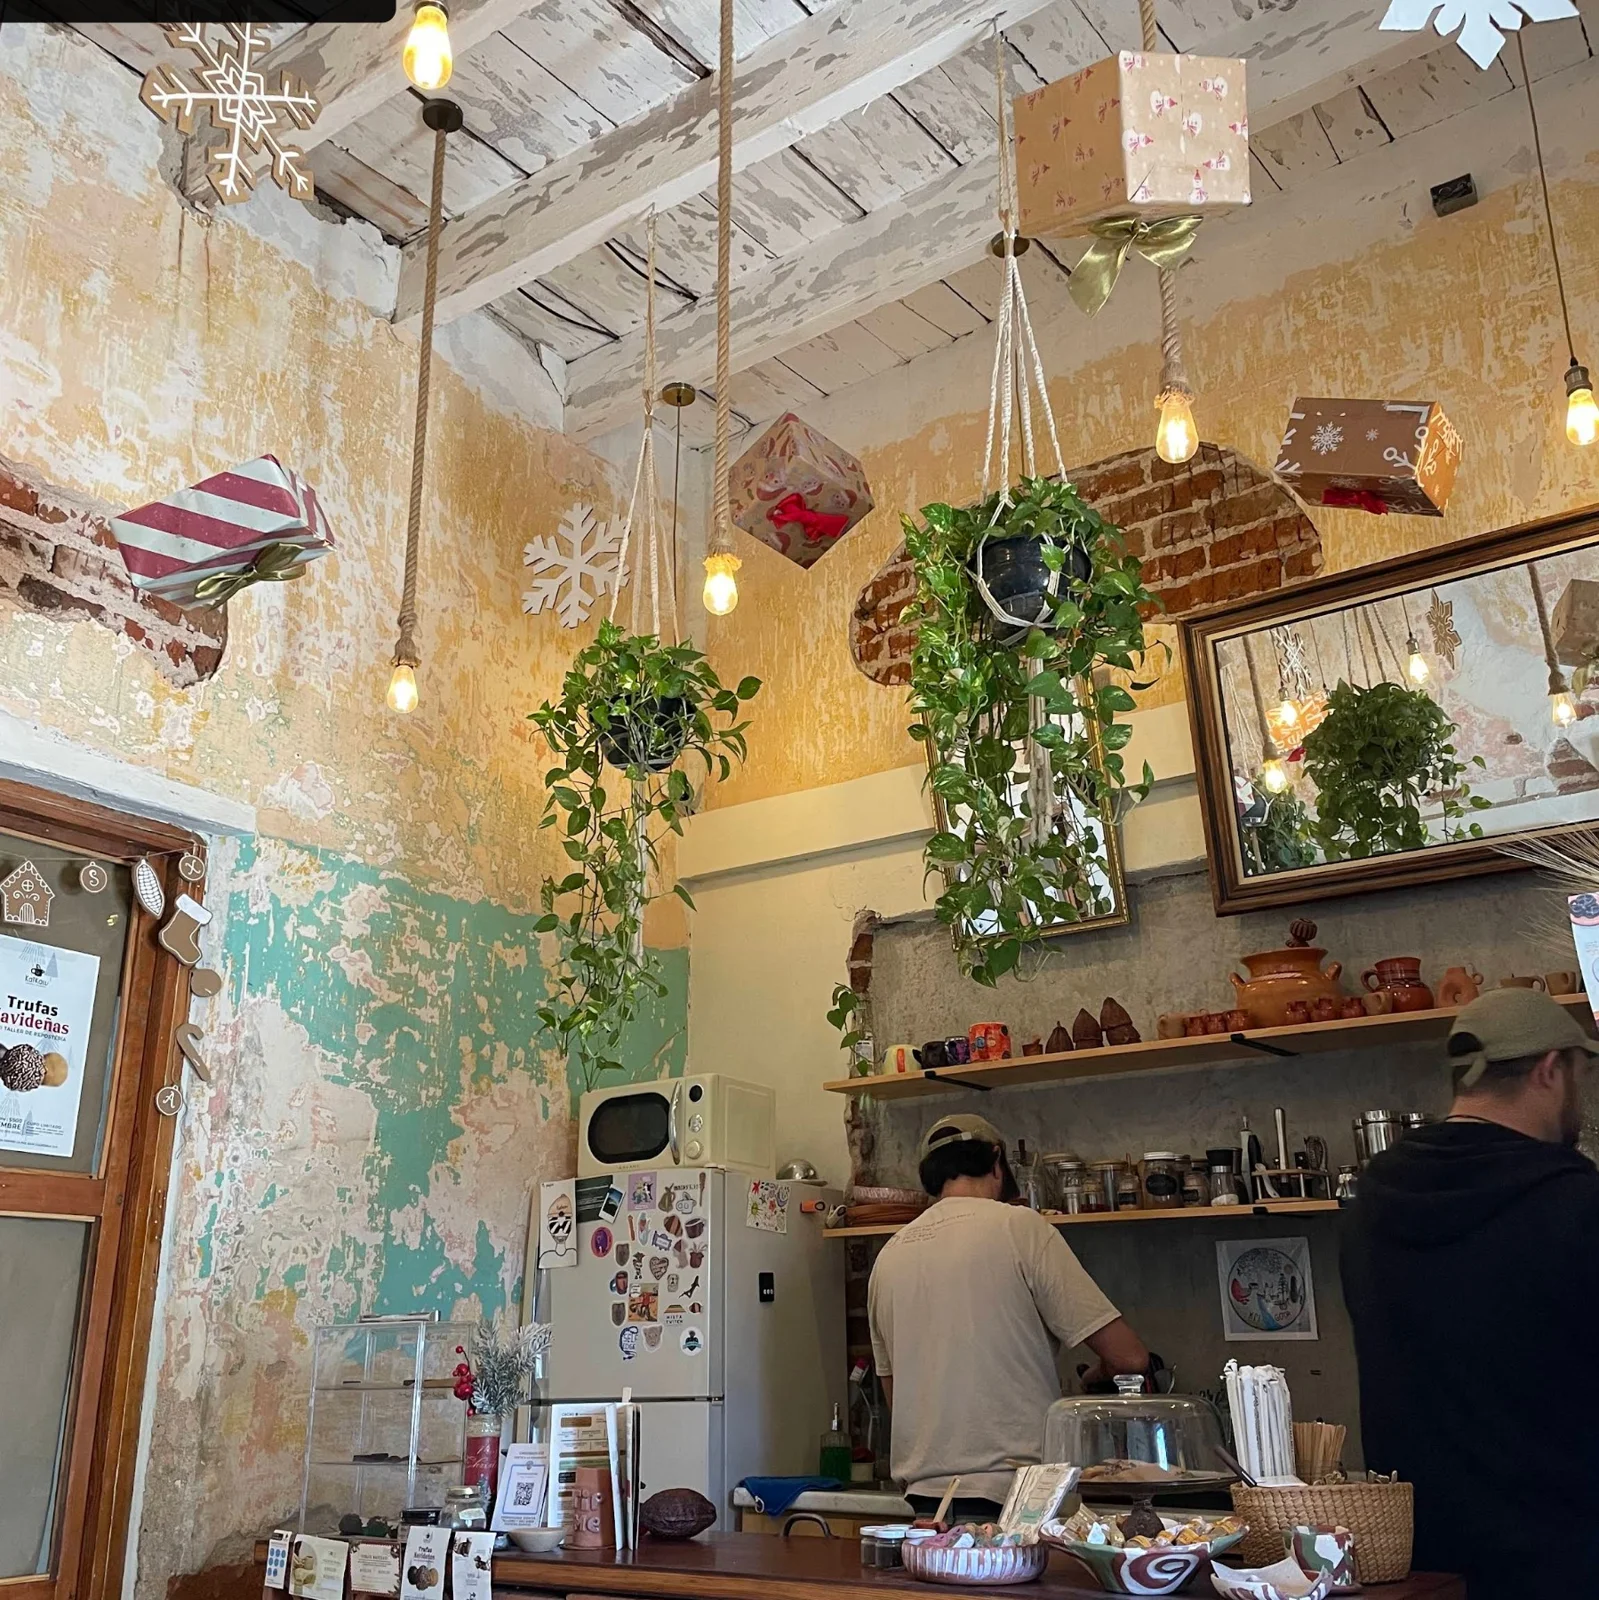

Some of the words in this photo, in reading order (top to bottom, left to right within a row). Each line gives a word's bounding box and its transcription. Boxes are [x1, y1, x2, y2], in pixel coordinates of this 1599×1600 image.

[184, 859, 201, 876] X
[88, 869, 100, 887] S
[7, 994, 59, 1017] Trufas
[0, 1011, 70, 1036] avideñas
[162, 1090, 176, 1109] A
